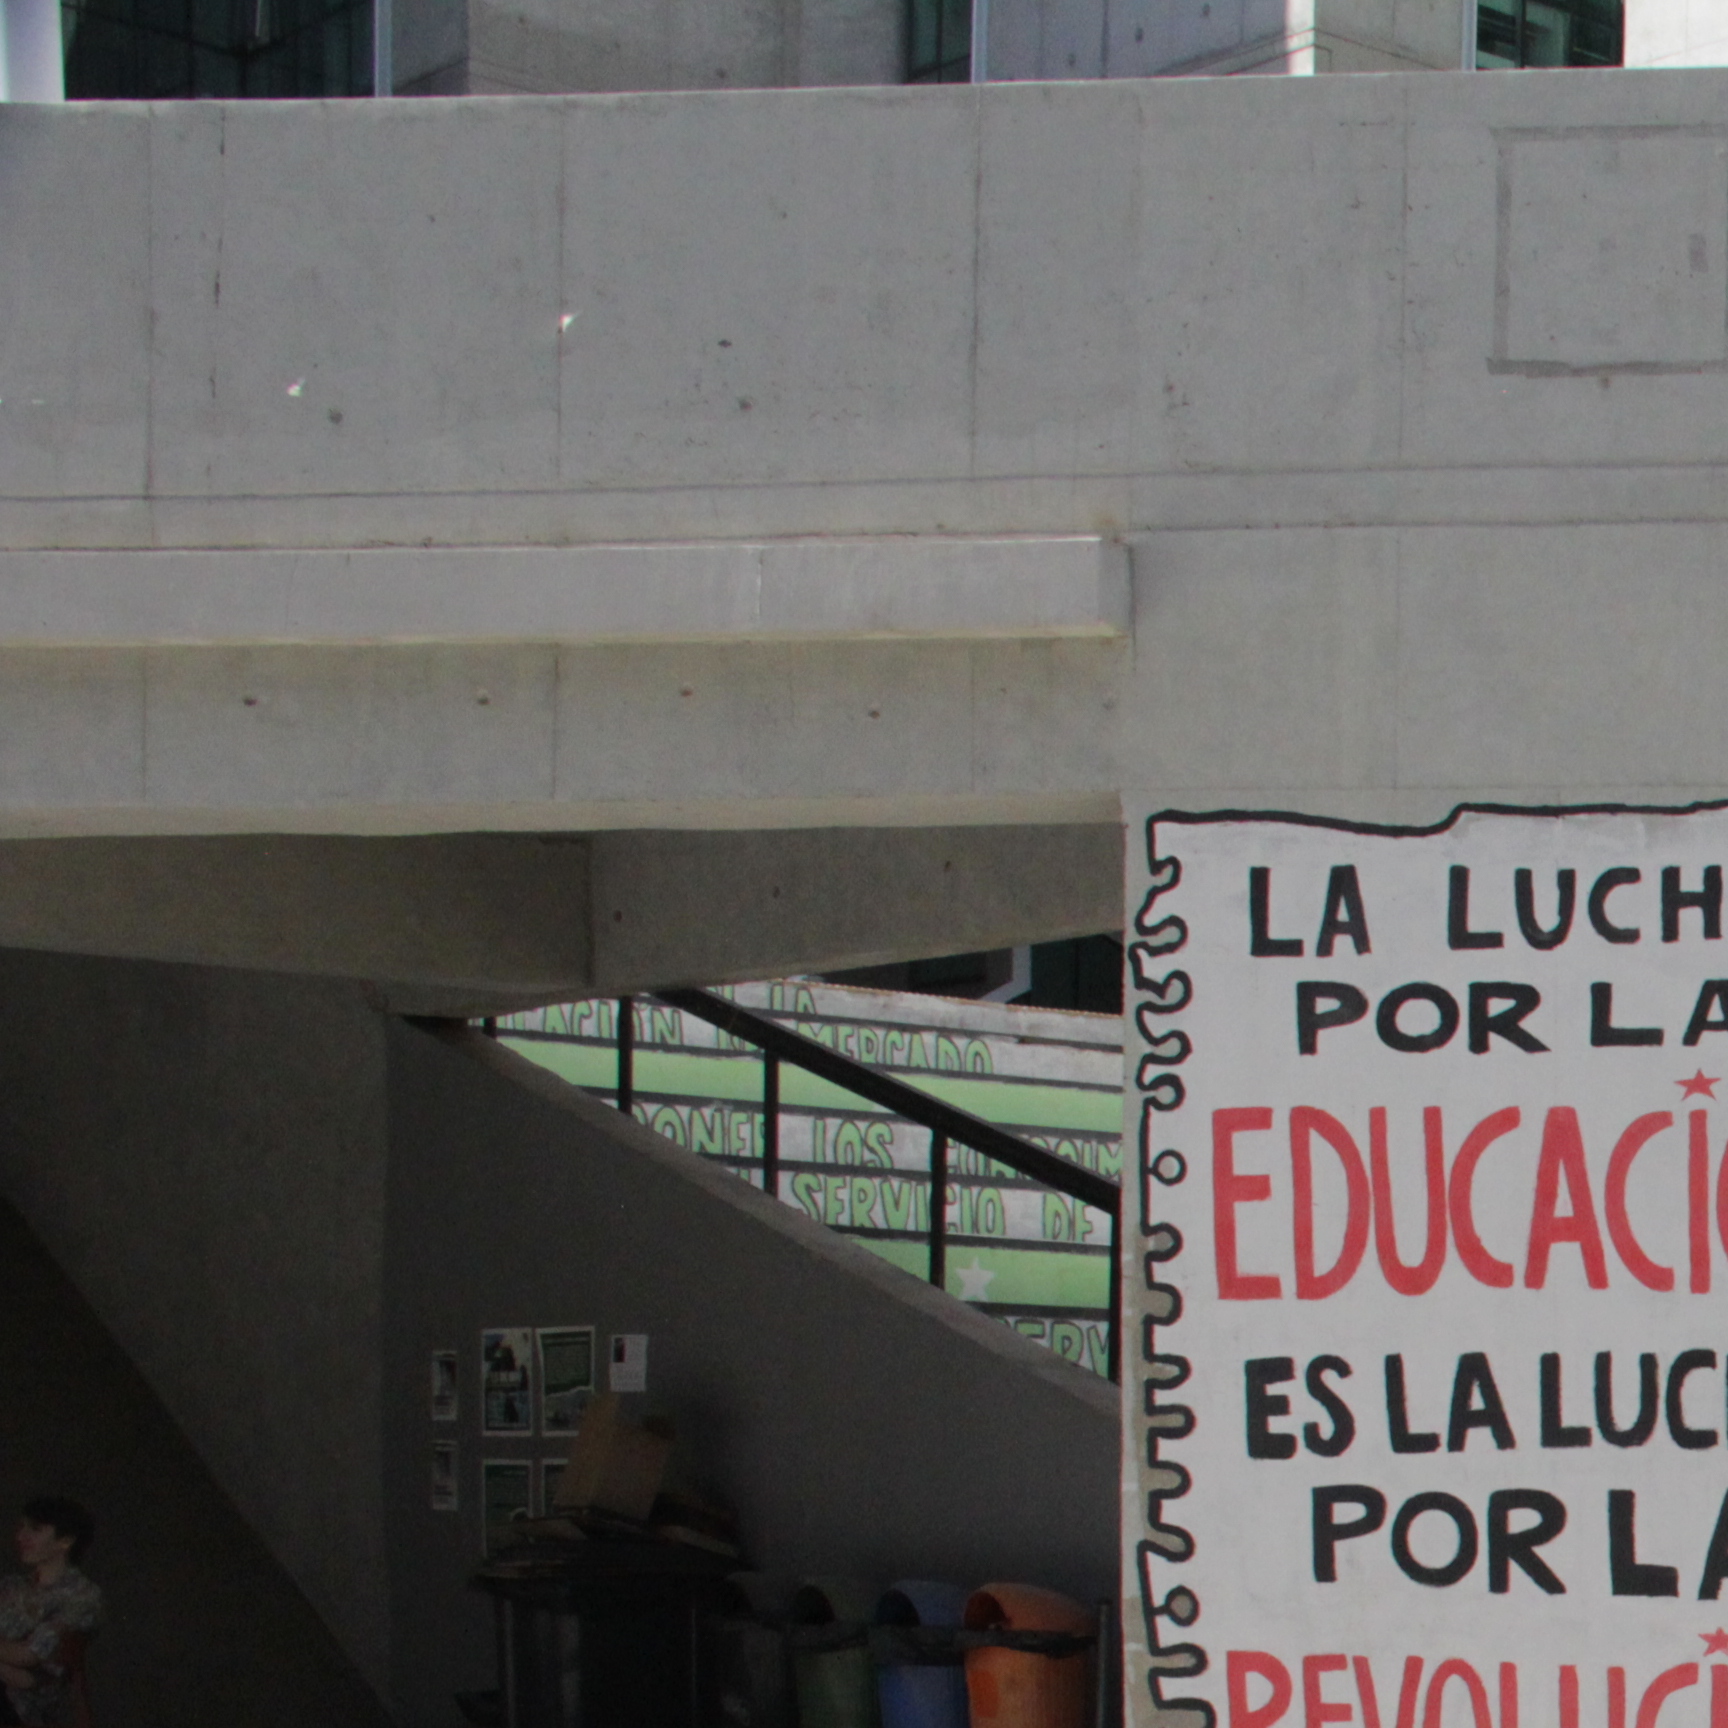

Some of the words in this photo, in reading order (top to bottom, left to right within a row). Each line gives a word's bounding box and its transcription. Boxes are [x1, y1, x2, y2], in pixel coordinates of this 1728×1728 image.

[1249, 864, 1371, 957] LA
[1295, 981, 1551, 1056] POR
[1042, 1190, 1094, 1243] DE
[1245, 1354, 1355, 1460] ES
[1385, 1352, 1517, 1454] LA
[1311, 1484, 1567, 1595] POR
